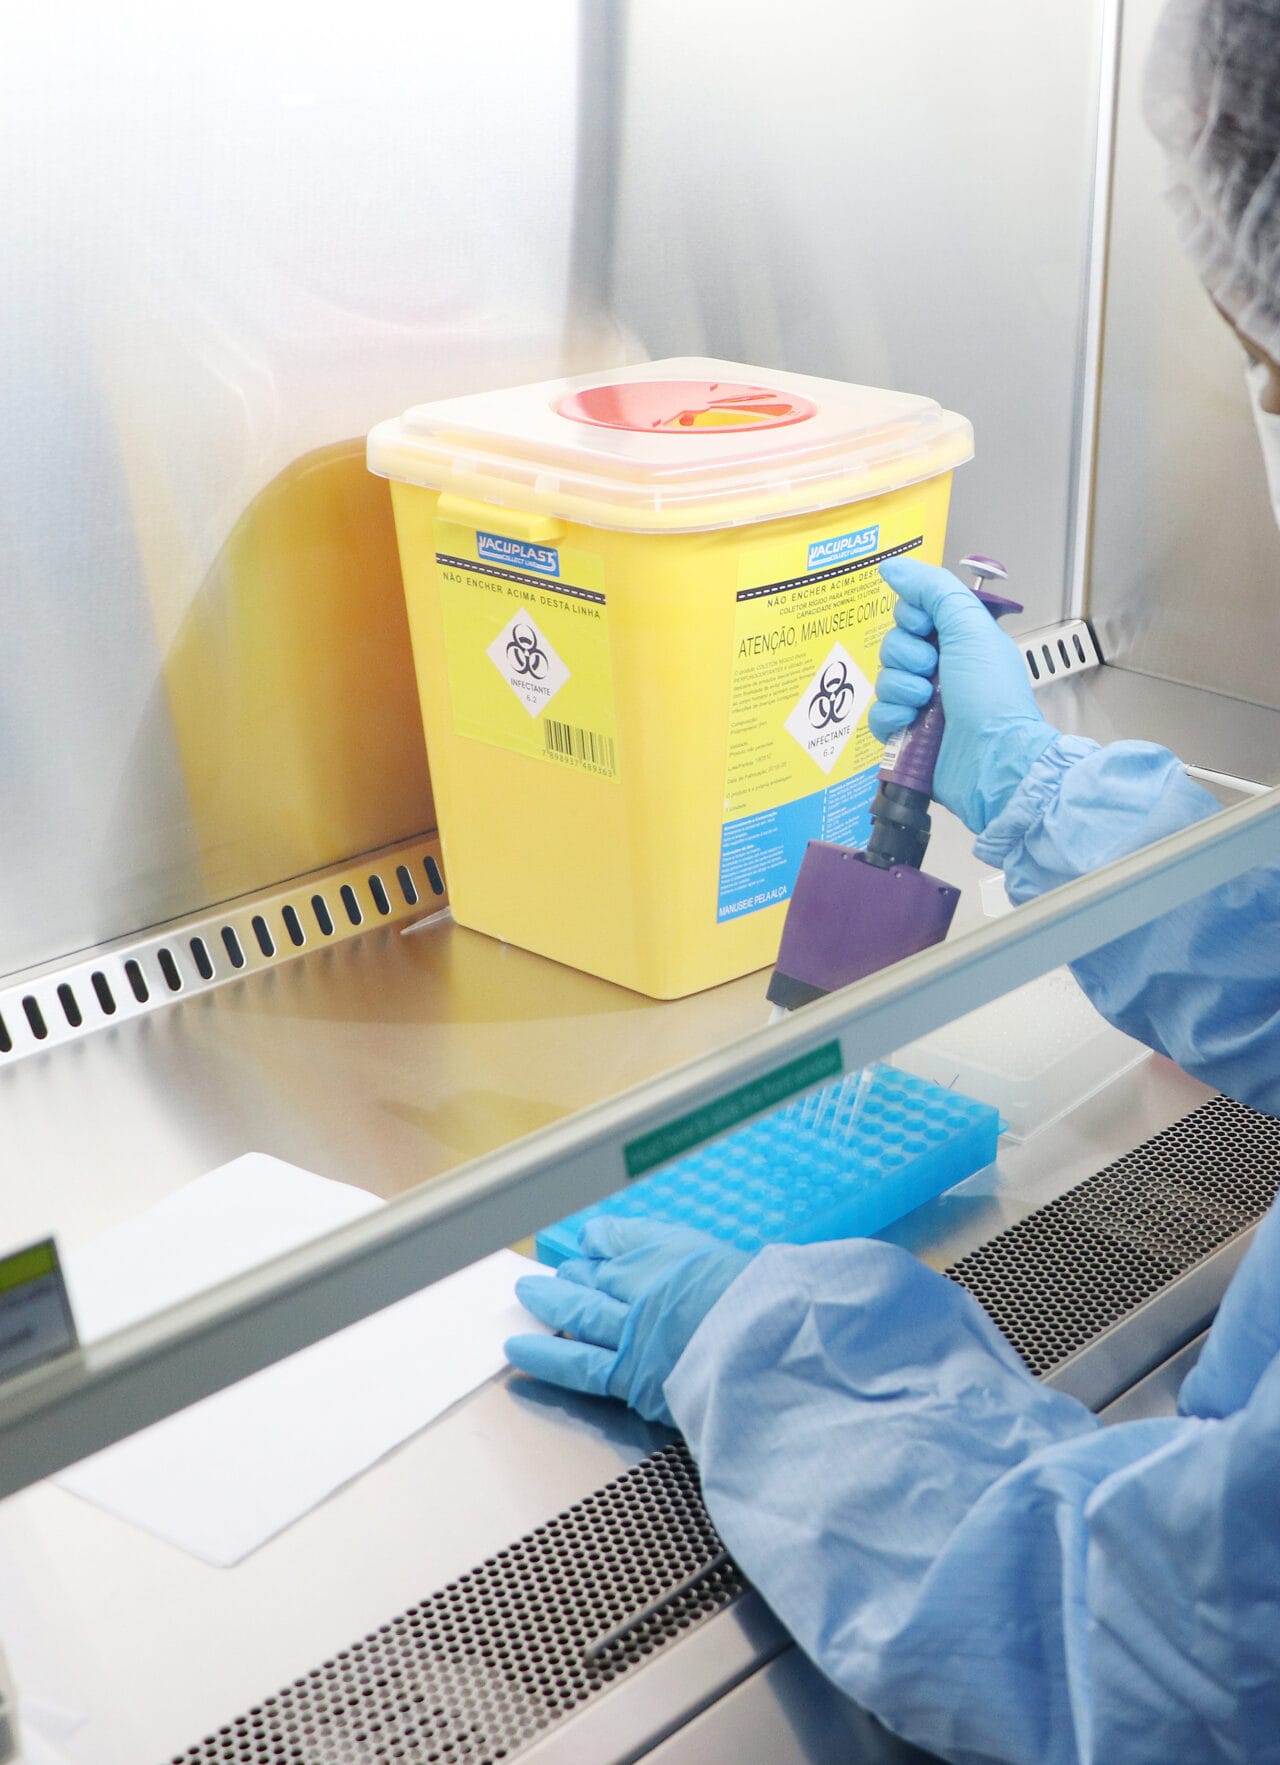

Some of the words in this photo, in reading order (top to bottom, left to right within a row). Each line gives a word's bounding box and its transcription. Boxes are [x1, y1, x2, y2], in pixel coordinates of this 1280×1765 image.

[479, 535, 555, 564] VACUPLAST
[810, 529, 876, 558] VACUPLAST
[443, 572, 462, 584] NÃO
[466, 577, 503, 594] ENCHER
[507, 587, 536, 602] ACIMA
[540, 596, 570, 611] DESTA
[573, 604, 601, 619] LINHA
[767, 594, 787, 608] NÃO
[791, 585, 826, 602] ENCHER
[831, 577, 855, 590] ACIMA
[859, 568, 878, 582] DEST
[738, 625, 798, 658] ATENÇÃO,
[801, 608, 854, 643] MANUSEIE
[857, 600, 878, 624] COM
[510, 678, 551, 697] INFECTANTE
[526, 694, 537, 704] 6.2
[807, 725, 851, 750] INFECTANTE
[823, 746, 835, 757] 6.2
[719, 897, 754, 916] MANUSEIE
